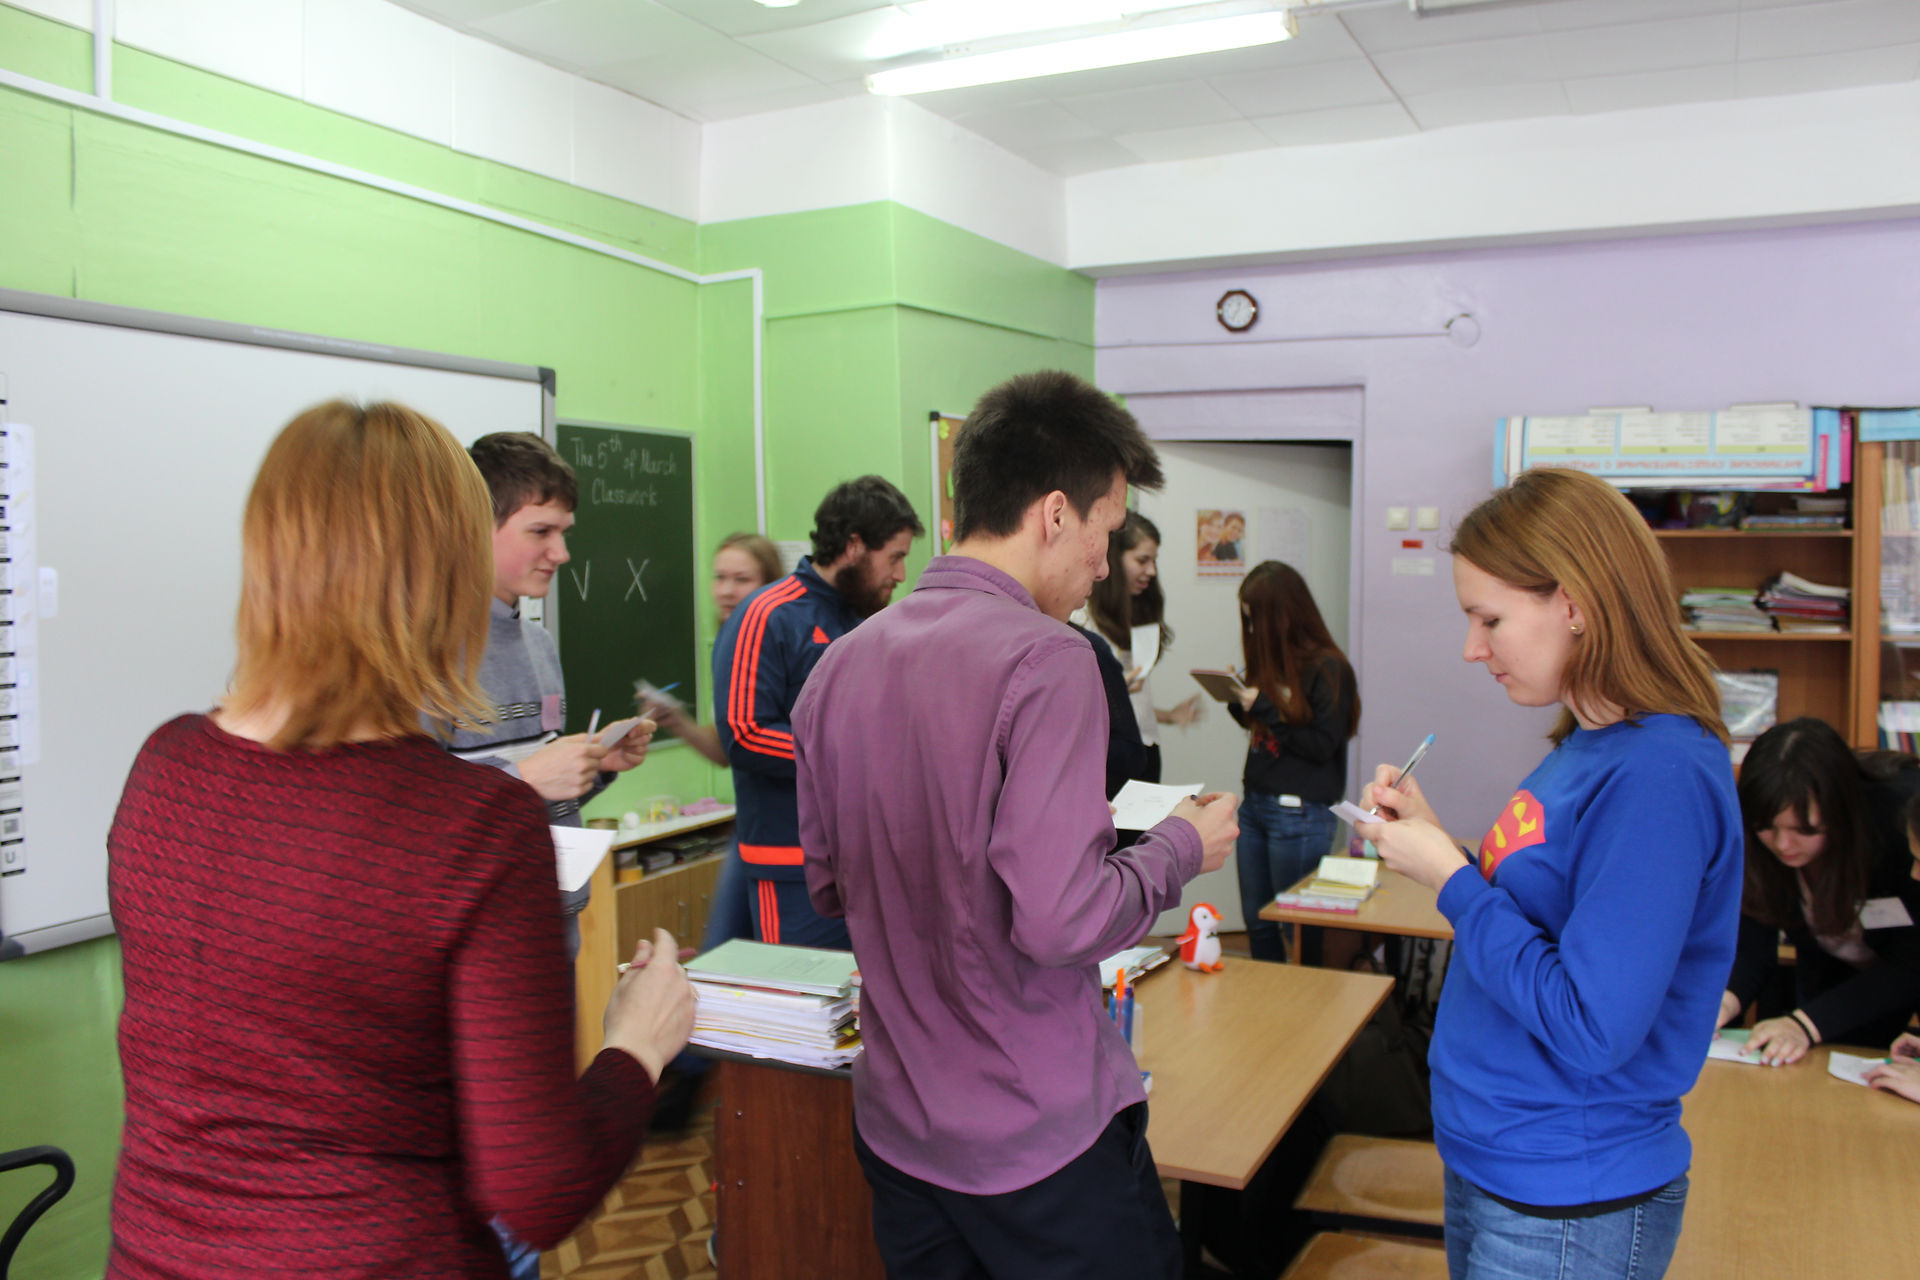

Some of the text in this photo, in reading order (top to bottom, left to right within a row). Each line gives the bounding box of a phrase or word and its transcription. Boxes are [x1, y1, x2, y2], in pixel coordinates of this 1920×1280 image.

[570, 437, 593, 468] The
[623, 448, 638, 479] of
[641, 447, 677, 476] March
[591, 478, 657, 507] Classwork
